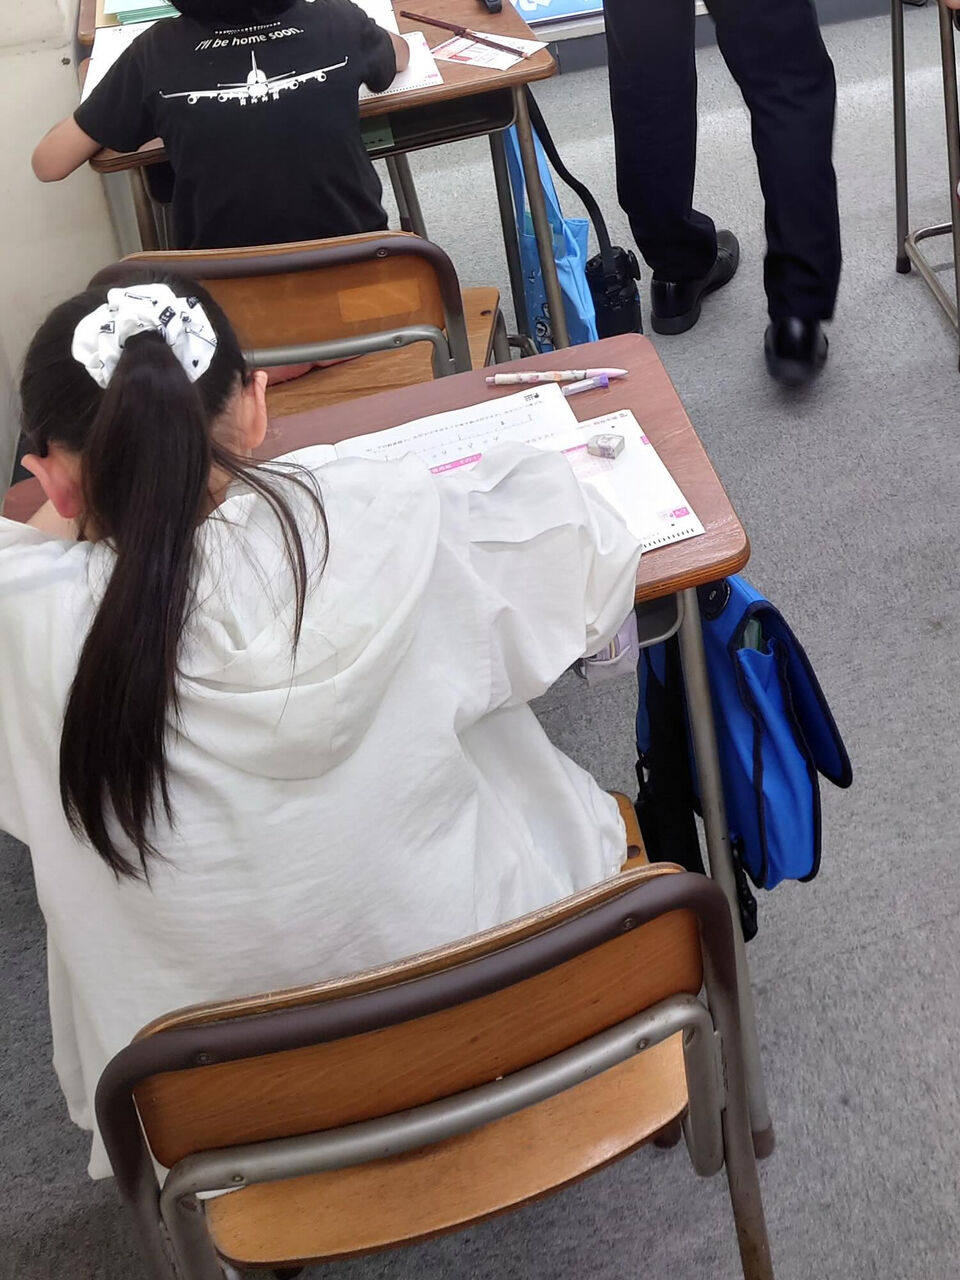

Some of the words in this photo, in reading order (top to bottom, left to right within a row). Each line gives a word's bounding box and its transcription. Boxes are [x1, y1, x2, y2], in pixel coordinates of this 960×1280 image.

[212, 39, 229, 47] be
[232, 34, 266, 46] home
[268, 27, 304, 39] soon.
